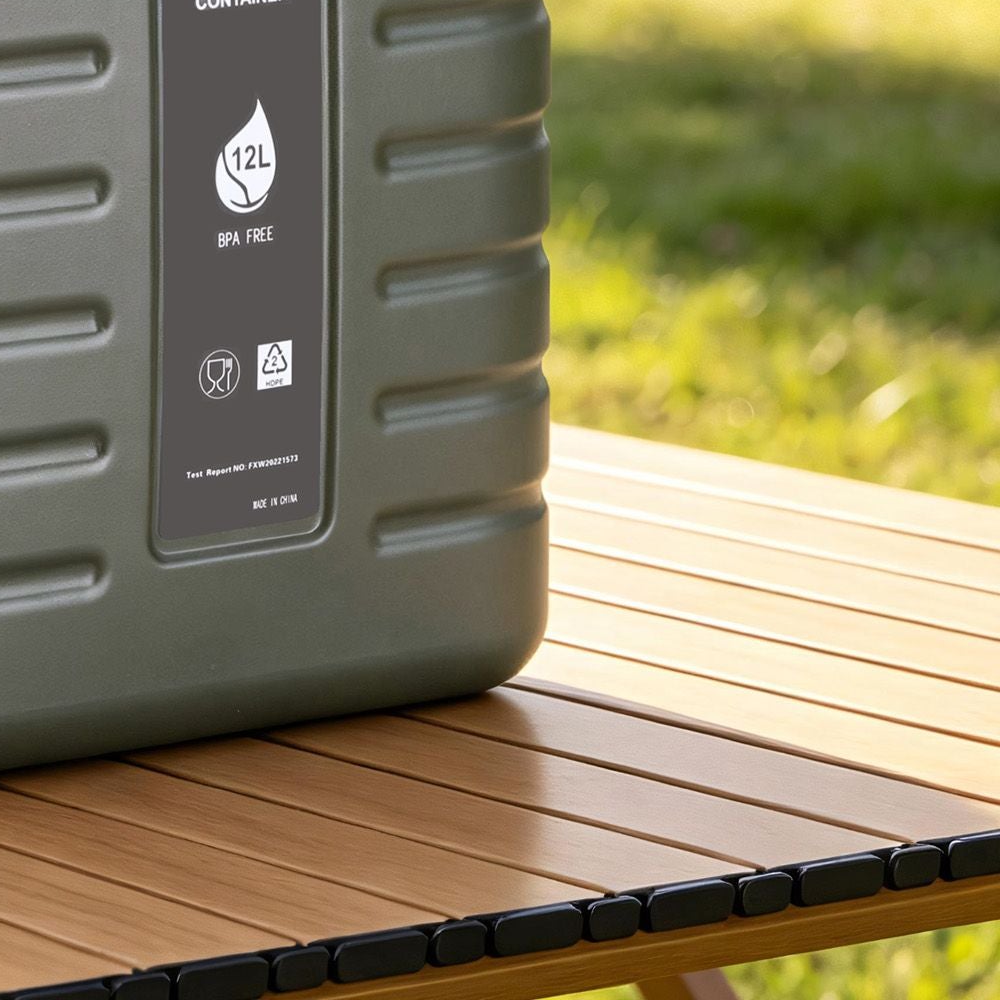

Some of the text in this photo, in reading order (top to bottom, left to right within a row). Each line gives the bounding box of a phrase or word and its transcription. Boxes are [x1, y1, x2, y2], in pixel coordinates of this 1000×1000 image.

[232, 143, 271, 171] 12L
[218, 225, 274, 248] BPA FREE
[271, 355, 278, 367] 2
[265, 378, 284, 387] HDPE
[186, 471, 203, 479] Test
[206, 466, 232, 477] Report
[248, 454, 299, 470] FXW20221573
[252, 493, 298, 510] MADE IN CHINA
